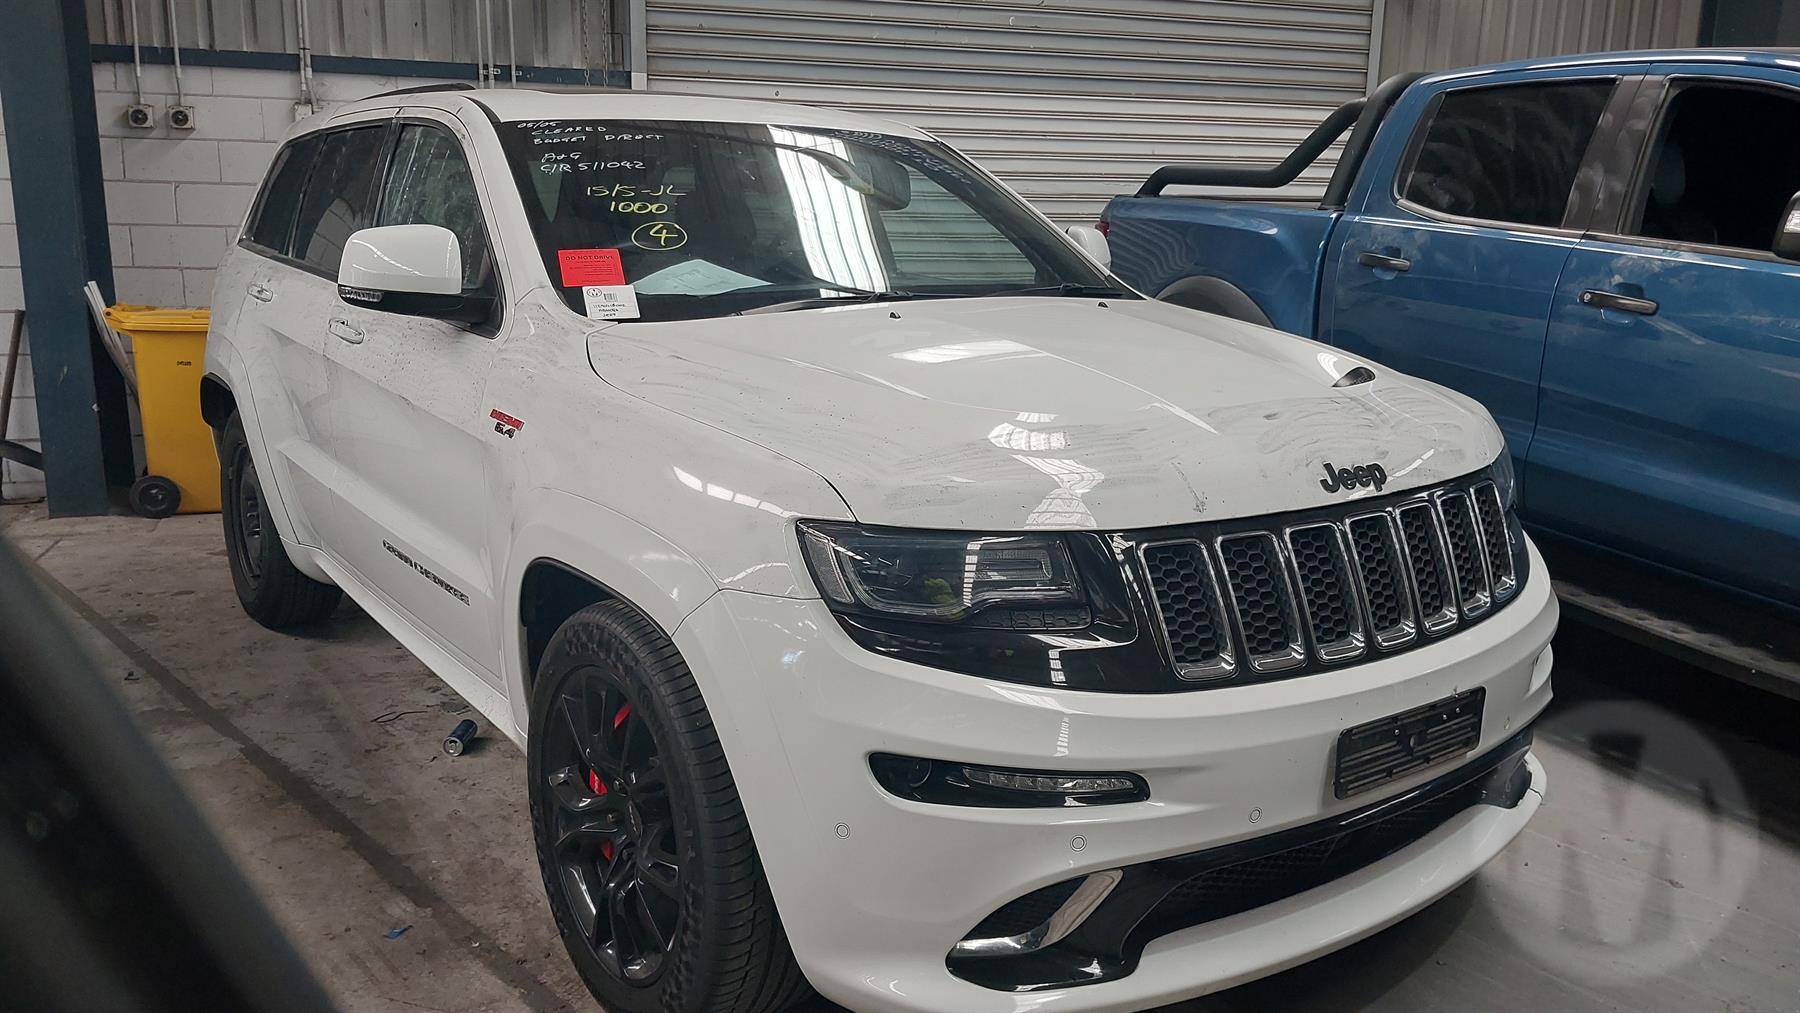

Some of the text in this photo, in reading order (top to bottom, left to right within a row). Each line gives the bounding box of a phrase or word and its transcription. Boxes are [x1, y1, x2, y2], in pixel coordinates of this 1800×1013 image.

[531, 126, 607, 136] CLEARED
[577, 161, 646, 171] 511042
[610, 201, 668, 214] 1000
[649, 223, 679, 246] 4
[1320, 462, 1388, 493] Jeep
